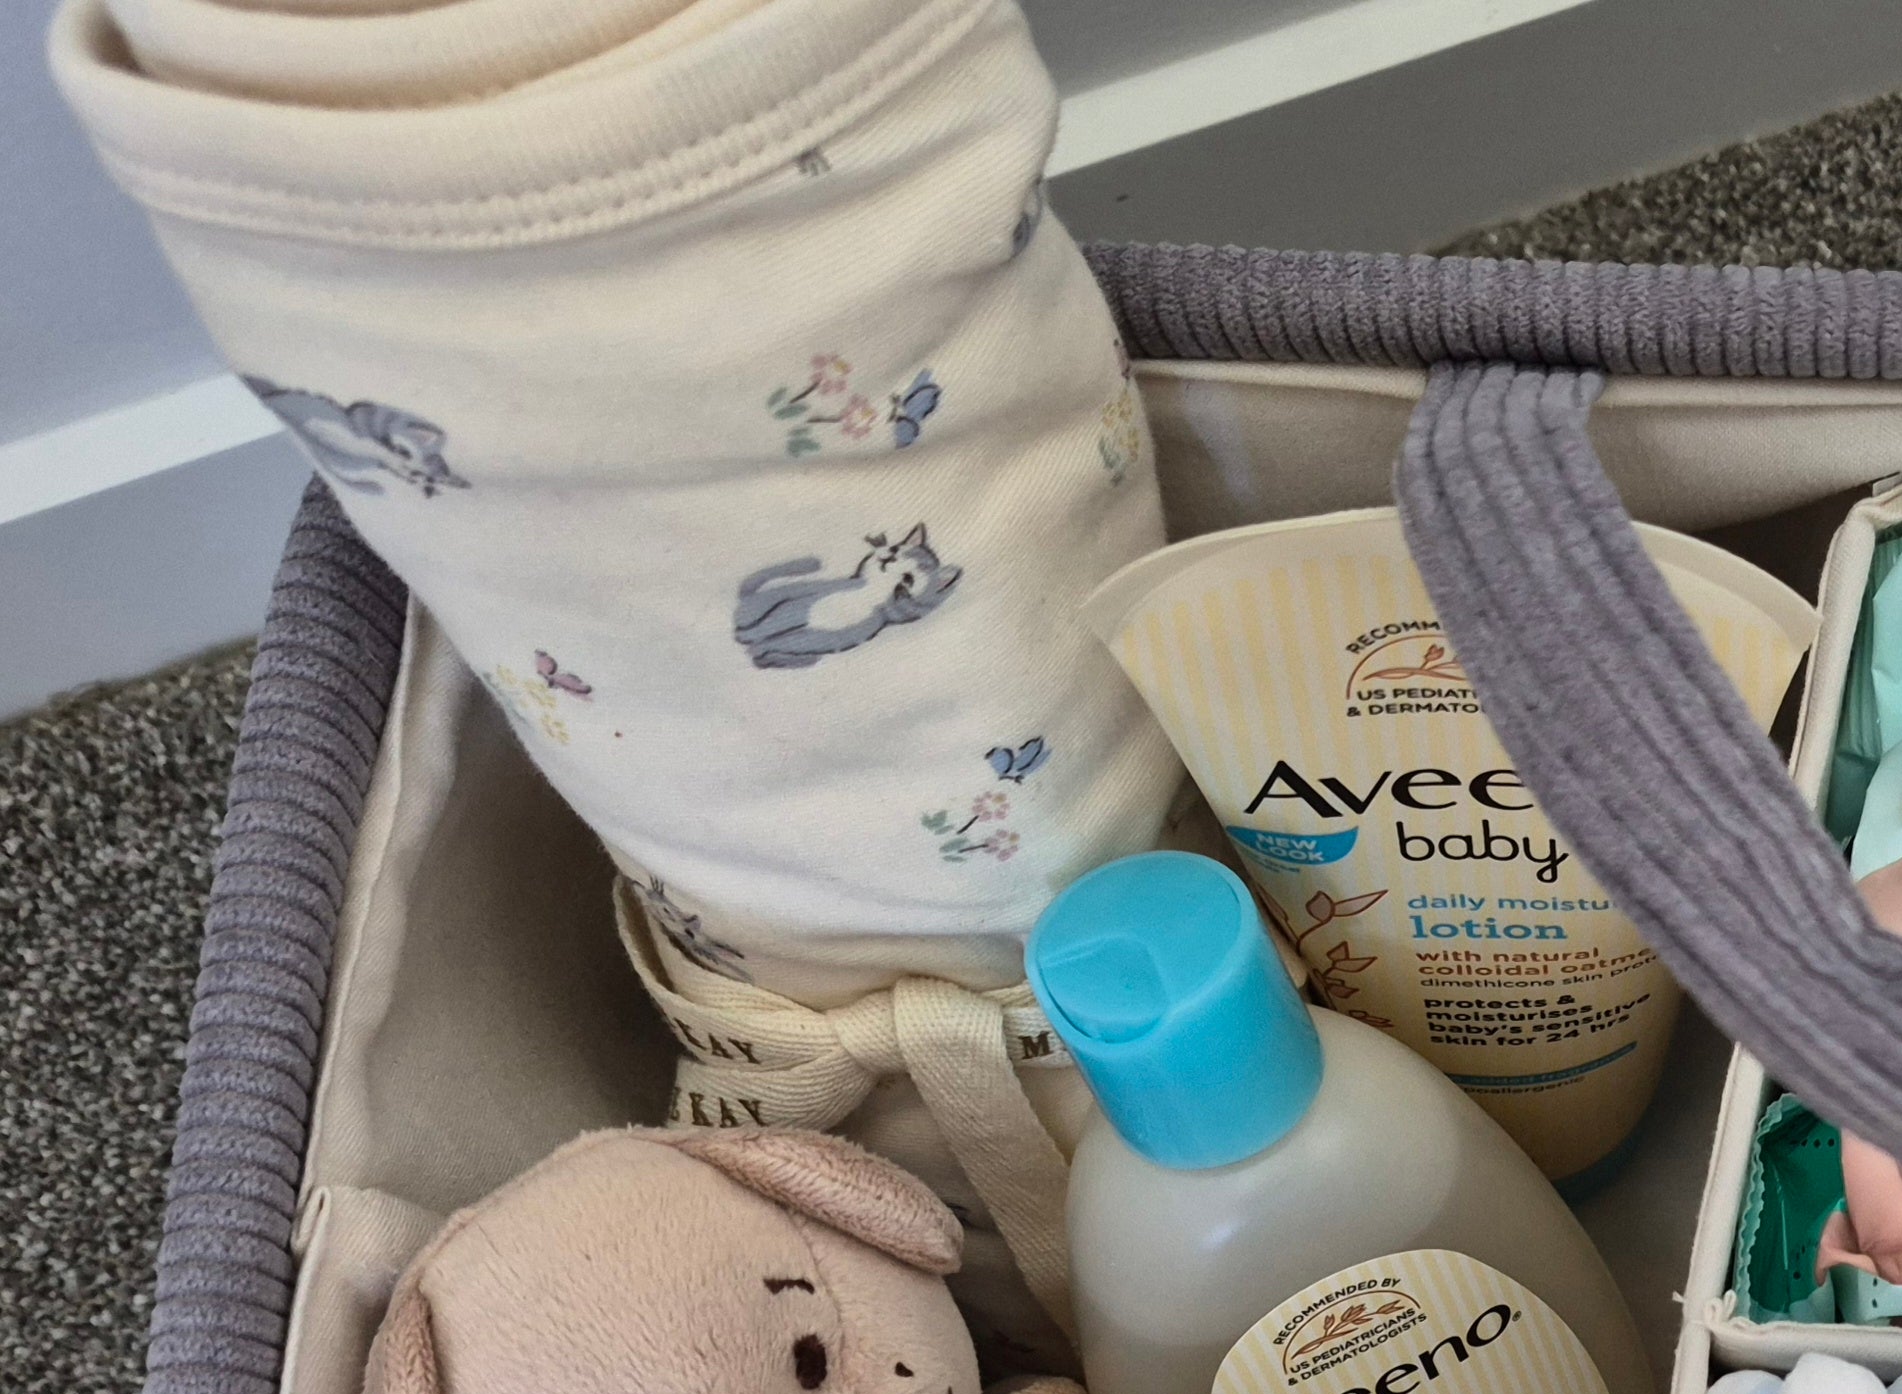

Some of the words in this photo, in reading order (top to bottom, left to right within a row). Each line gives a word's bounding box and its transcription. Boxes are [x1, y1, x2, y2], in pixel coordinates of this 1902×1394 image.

[1345, 620, 1441, 655] RECOMM
[1356, 687, 1387, 702] US
[1346, 706, 1361, 717] &
[1368, 702, 1483, 716] DERMATO
[1243, 759, 1535, 819] Avee
[1255, 842, 1324, 862] LOOK
[1256, 832, 1318, 850] NEW
[1395, 818, 1570, 884] baby
[1407, 893, 1486, 912] daily
[1497, 896, 1612, 912] moistu
[1409, 914, 1568, 940] lotion
[1415, 950, 1482, 963] with
[1492, 946, 1599, 963] natural
[1418, 963, 1550, 976] colloidal
[1560, 947, 1653, 974] oatme
[1419, 977, 1555, 988] dimethicone
[1561, 972, 1603, 987] skin
[1423, 996, 1548, 1011] protects
[1556, 994, 1577, 1006] &
[1425, 1002, 1594, 1023] moisturises
[1428, 1020, 1523, 1038] baby's
[1531, 992, 1651, 1034] sensitive
[1430, 1034, 1488, 1047] skin
[1495, 1034, 1538, 1047] for
[1546, 1028, 1580, 1044] 24
[1589, 1012, 1631, 1034] hrs
[1461, 1075, 1586, 1096] poallergenic
[1272, 1279, 1378, 1346] RECOMMENDED
[1380, 1277, 1402, 1289] BY
[1287, 1376, 1298, 1387] &
[1300, 1312, 1428, 1381] DERMATOLOGISTS
[1289, 1362, 1311, 1374] US
[1311, 1307, 1417, 1365] PEDIATRICIANS
